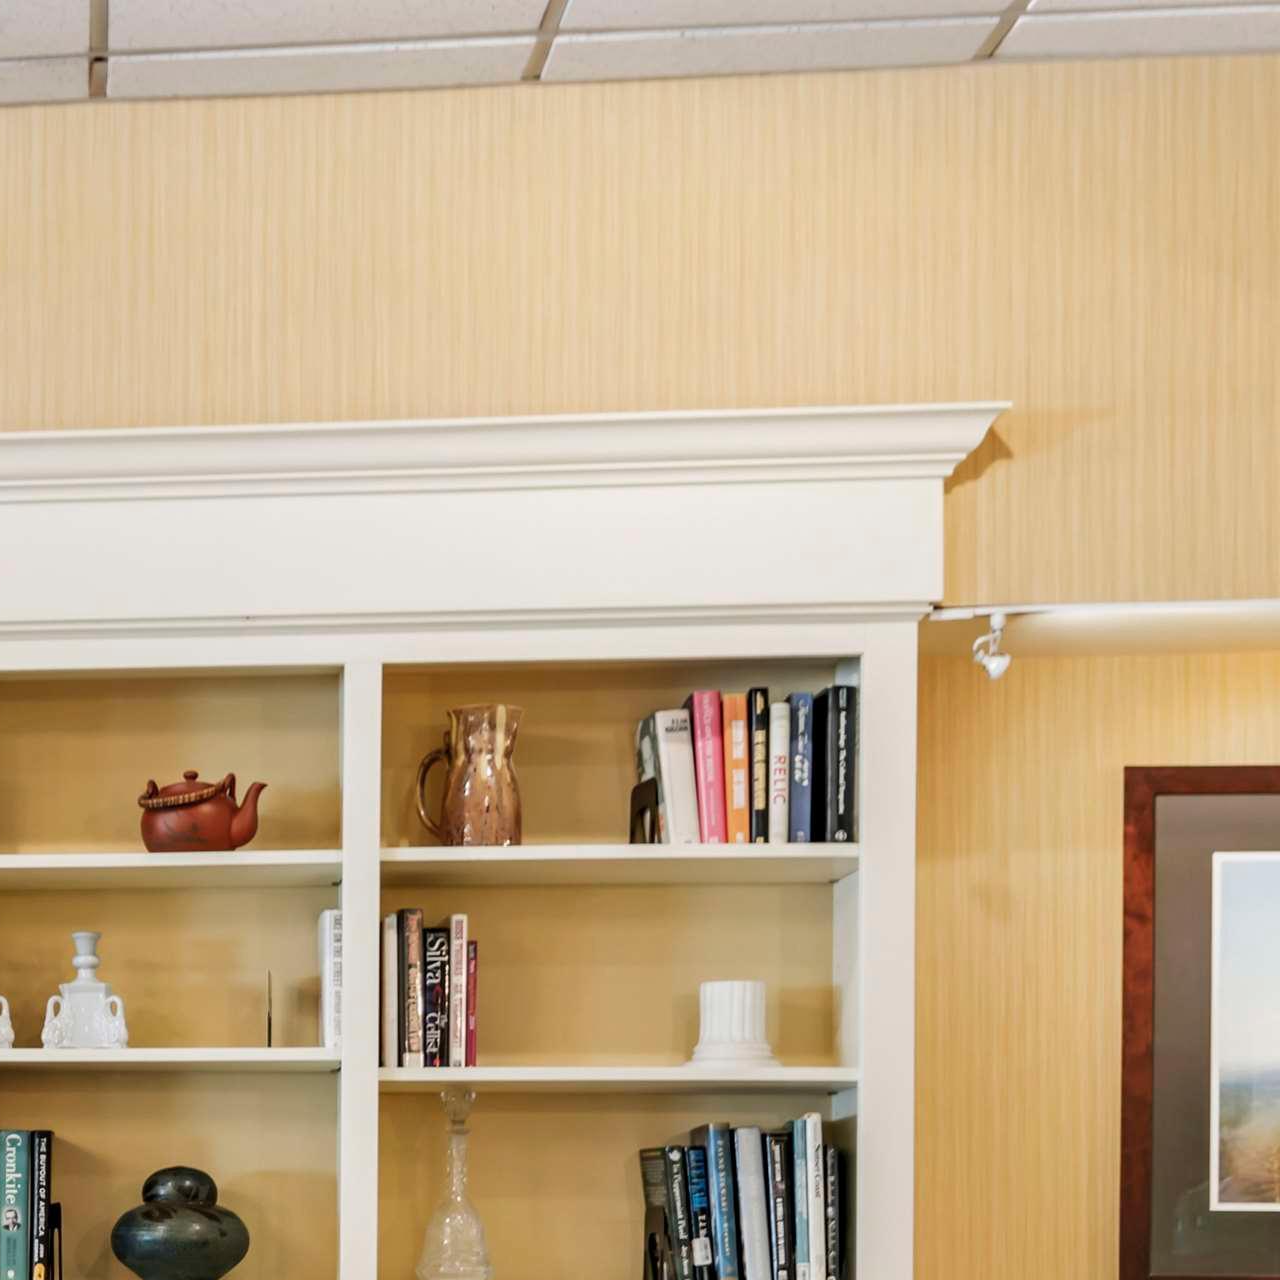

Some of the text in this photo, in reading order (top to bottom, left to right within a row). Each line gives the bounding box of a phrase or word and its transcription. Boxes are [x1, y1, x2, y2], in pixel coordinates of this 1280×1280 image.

[773, 755, 787, 806] RELIC
[425, 936, 448, 985] Silva
[425, 1012, 441, 1055] Cellist
[439, 1014, 449, 1029] The
[5, 1133, 23, 1206] Cronkite
[38, 1137, 47, 1237] THE BUYOUT OF AMERICA
[720, 1170, 729, 1212] STEWART
[671, 1174, 685, 1219] Peppermint
